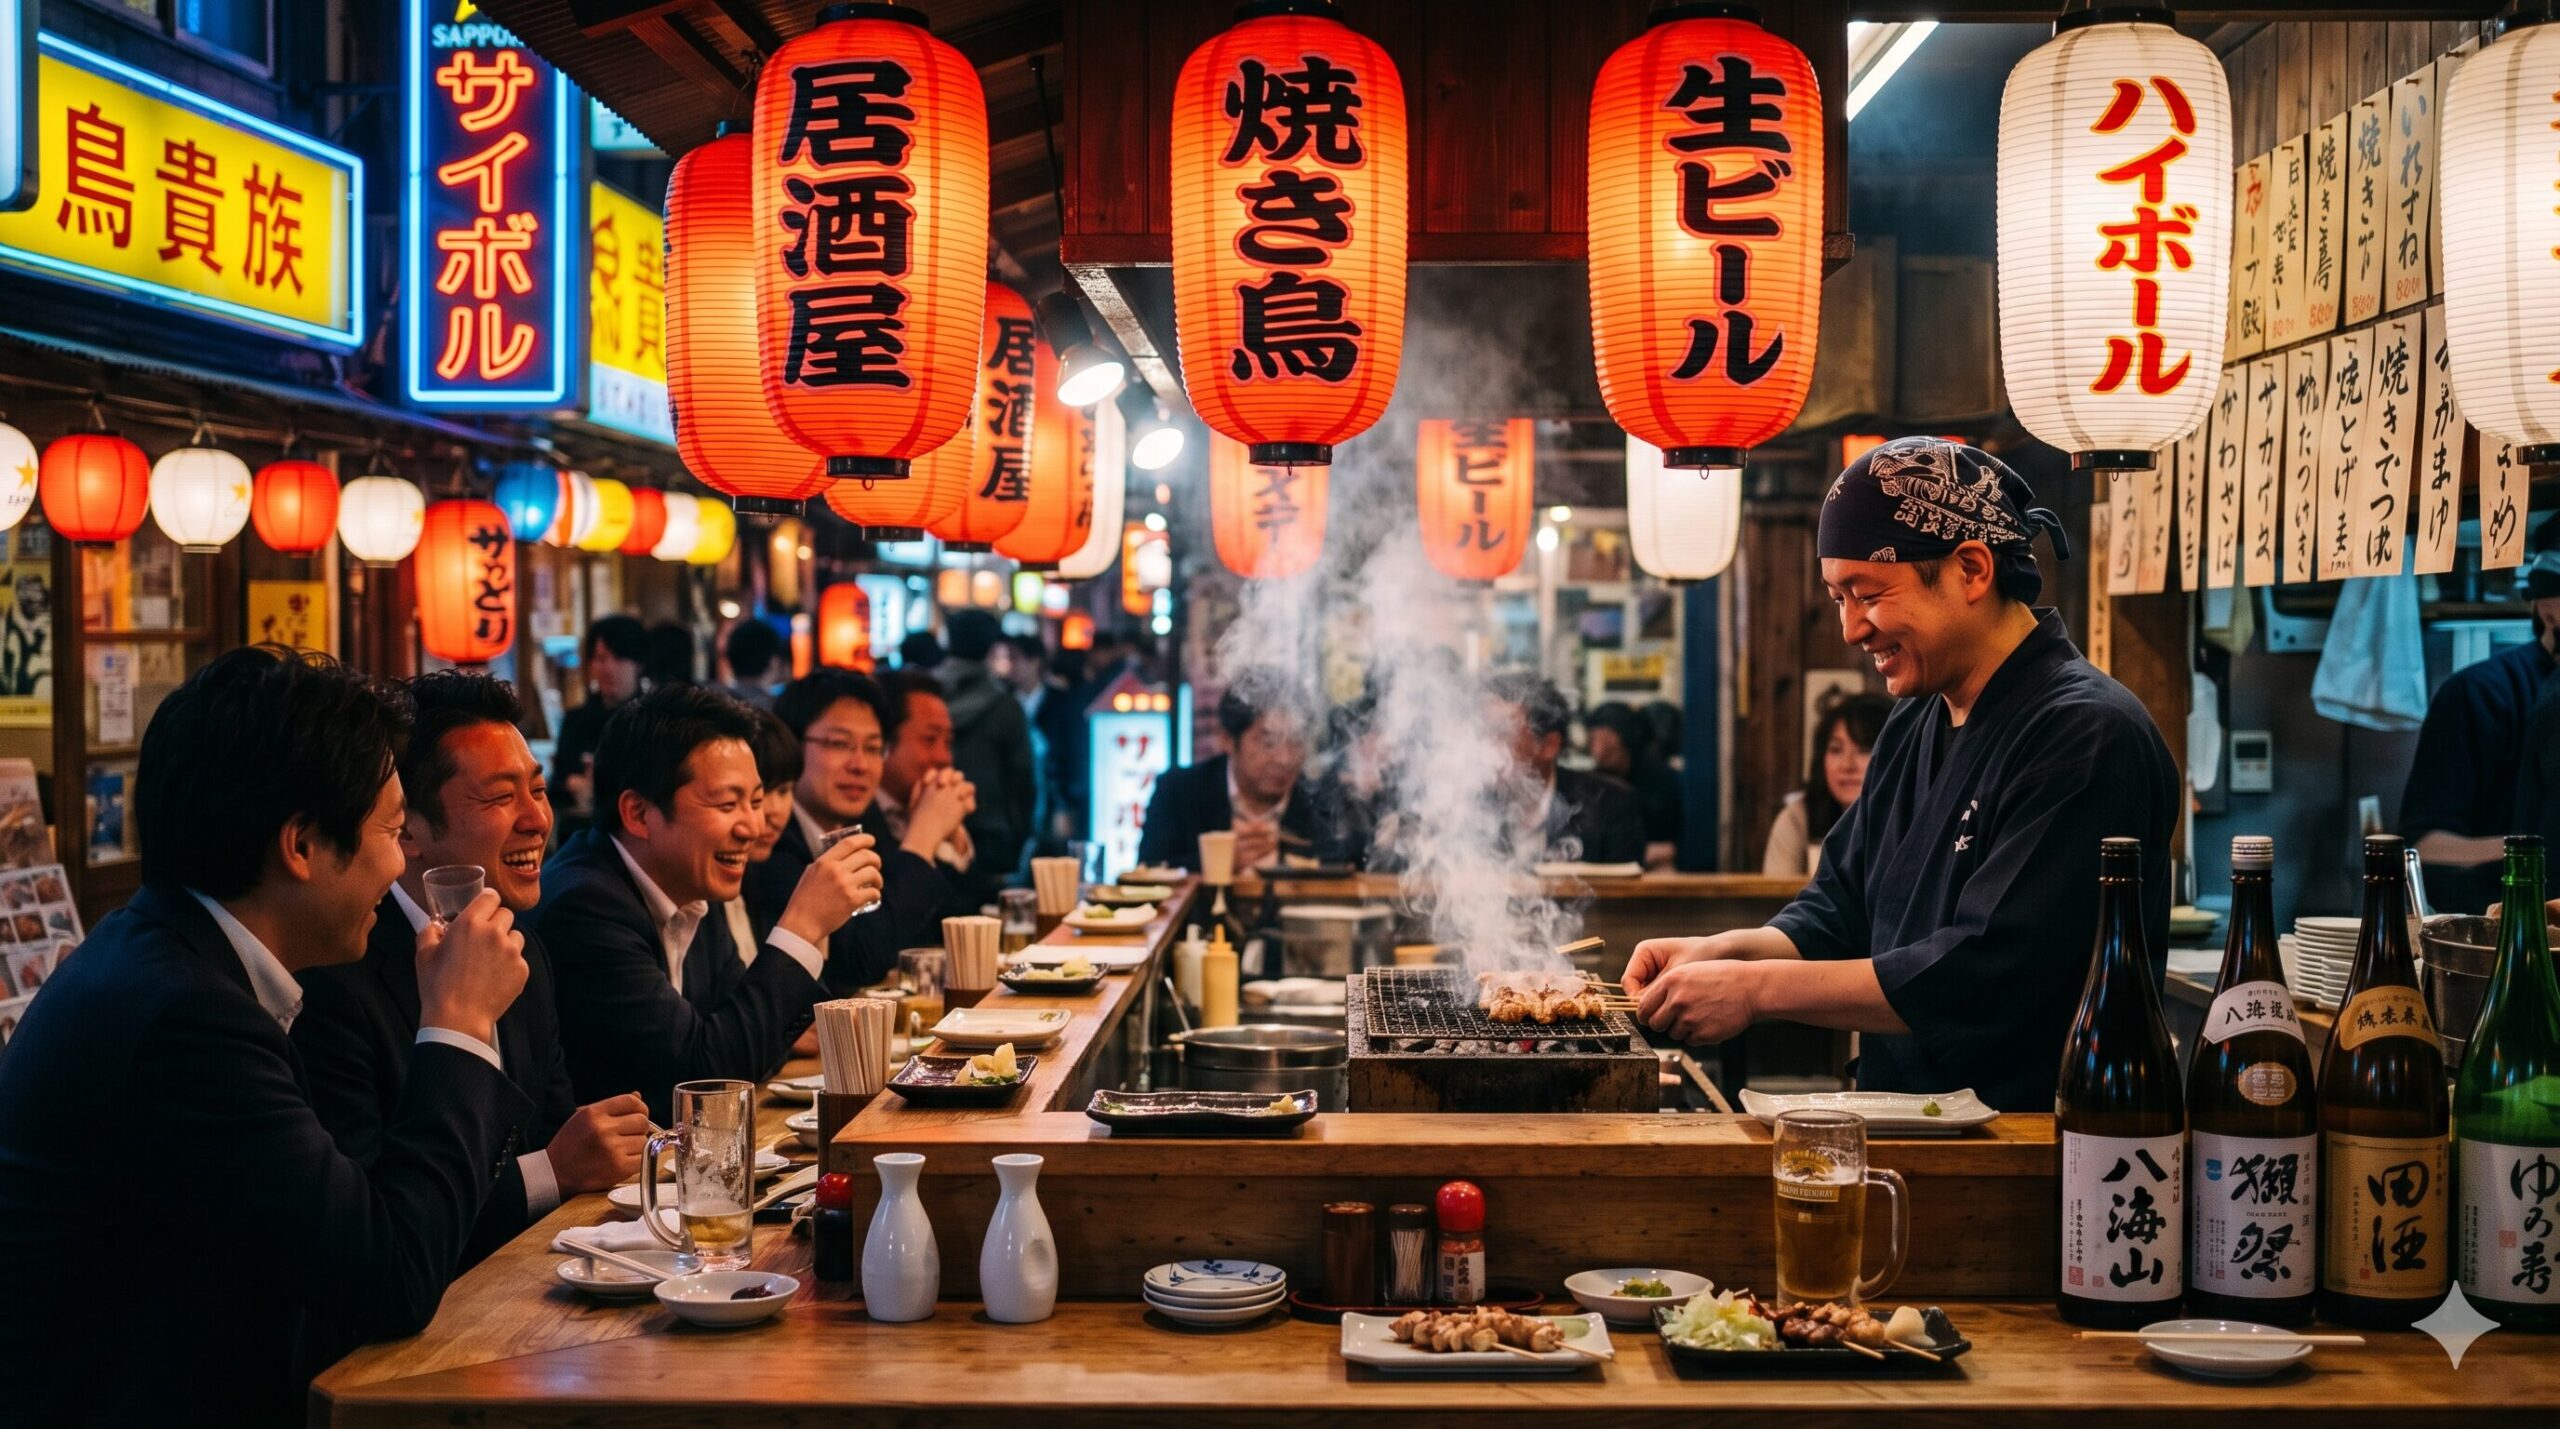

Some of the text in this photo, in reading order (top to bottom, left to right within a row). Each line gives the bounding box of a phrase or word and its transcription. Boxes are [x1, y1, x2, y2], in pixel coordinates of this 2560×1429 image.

[56, 102, 304, 297] 鳥貴族
[436, 50, 540, 380] サイボル
[780, 61, 917, 388] 居酒屋
[1222, 54, 1366, 384] 焼き鳥
[1664, 55, 1794, 385] 生ビール
[2090, 75, 2199, 396] ハイボール
[980, 316, 1036, 502] 居酒屋
[2101, 1148, 2170, 1289] 八海山
[2229, 1153, 2302, 1283] 獺祭
[2367, 1160, 2430, 1274] 田酒
